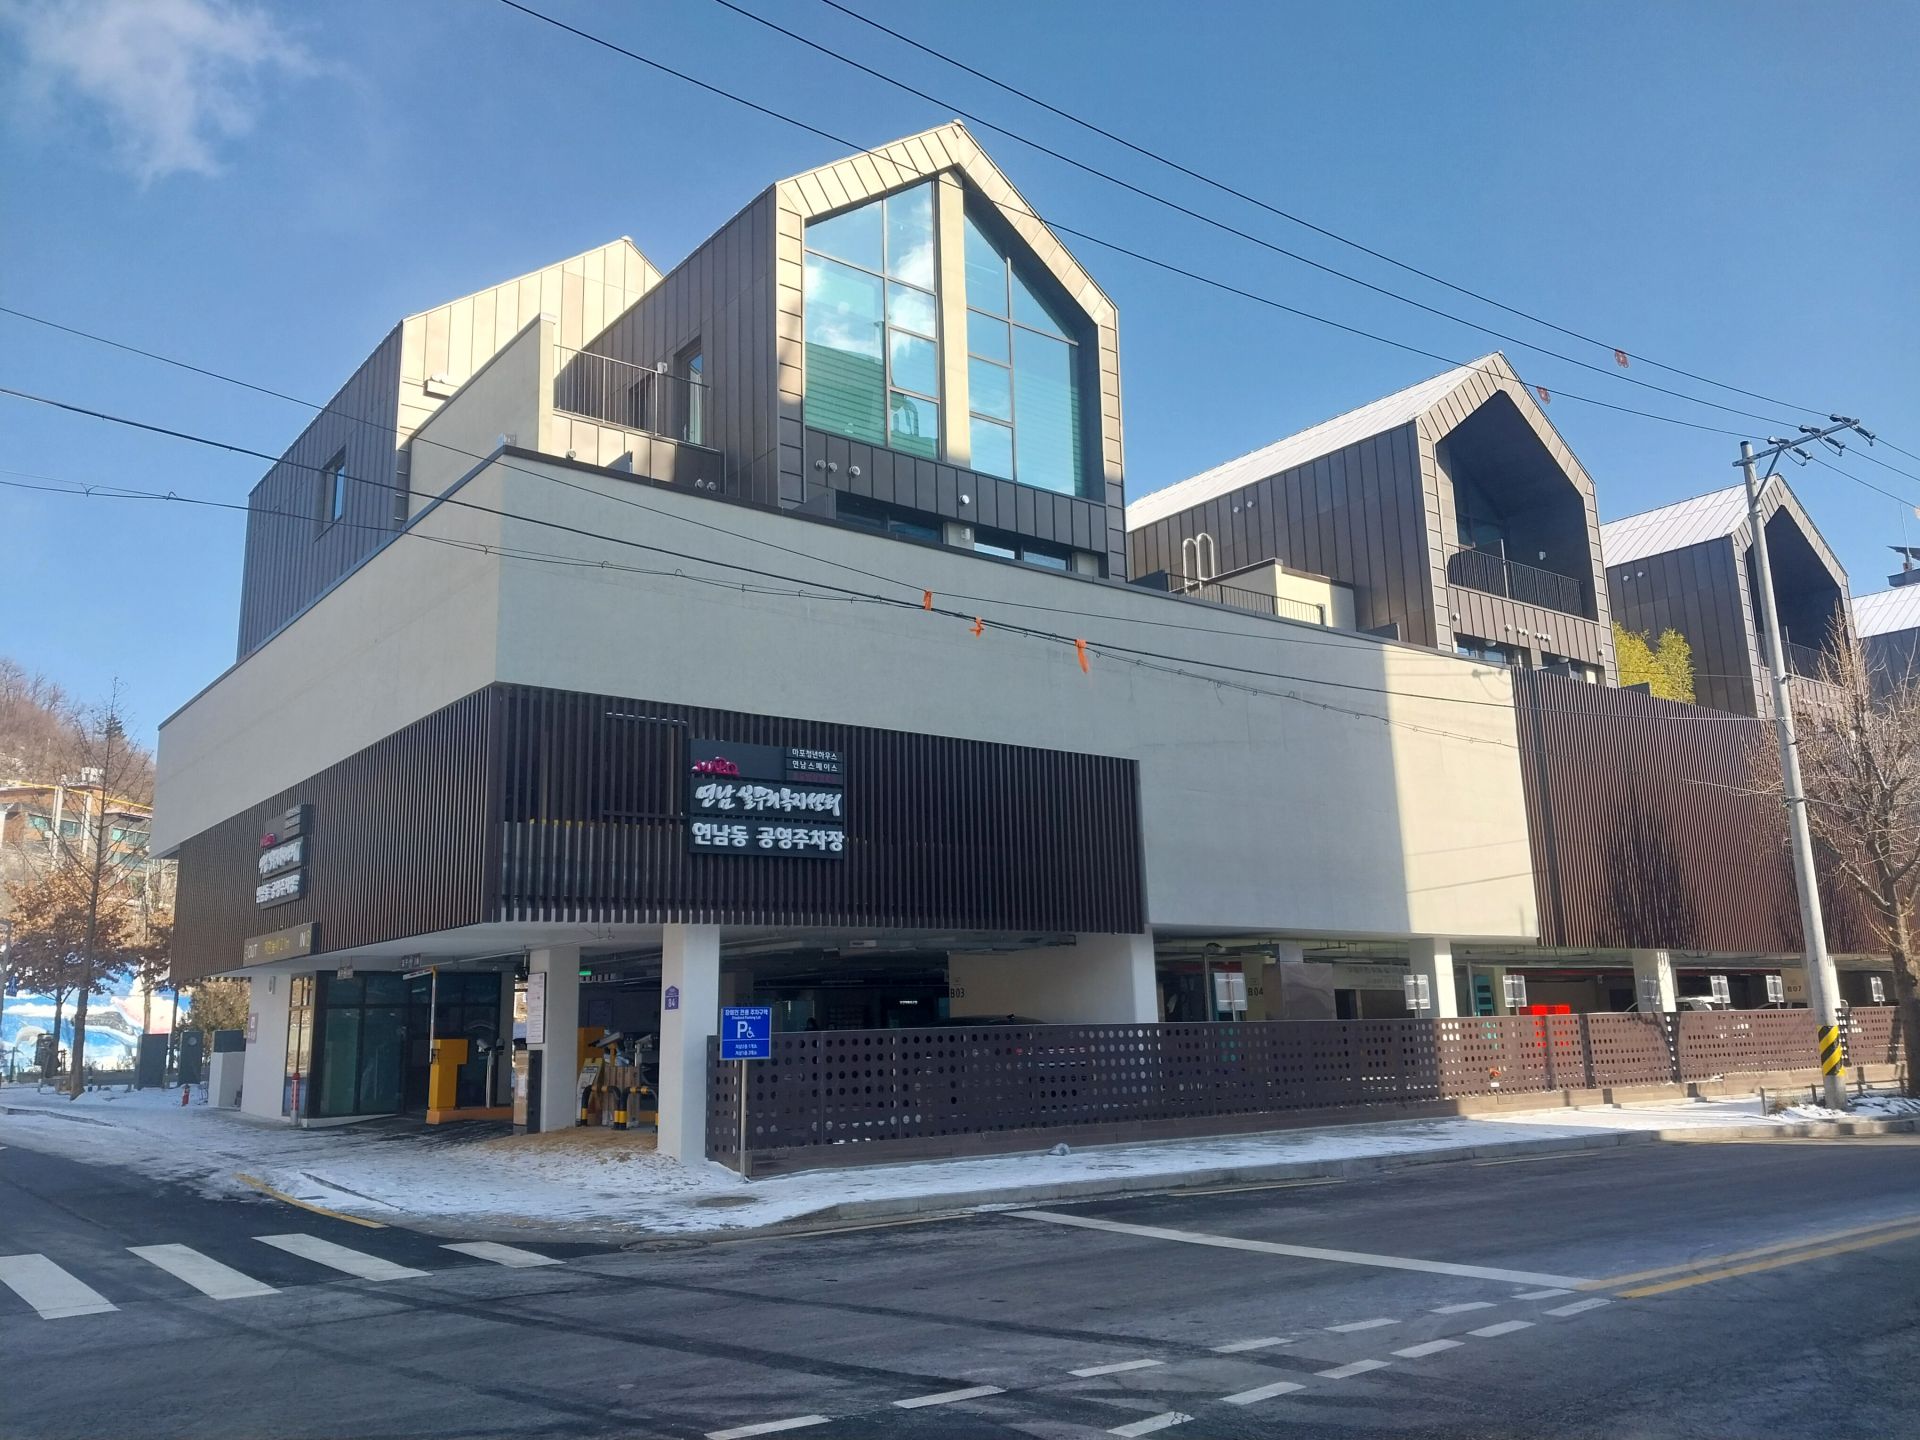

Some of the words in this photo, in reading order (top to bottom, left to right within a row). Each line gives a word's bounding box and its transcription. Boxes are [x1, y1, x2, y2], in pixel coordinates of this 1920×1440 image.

[792, 748, 838, 761] 마포청년하우스
[792, 760, 838, 772] 연남스페이스
[695, 783, 736, 810] 연남
[691, 822, 749, 847] 연남동
[756, 827, 845, 851] 공영주차장
[951, 987, 964, 998] B03
[737, 1021, 748, 1038] P
